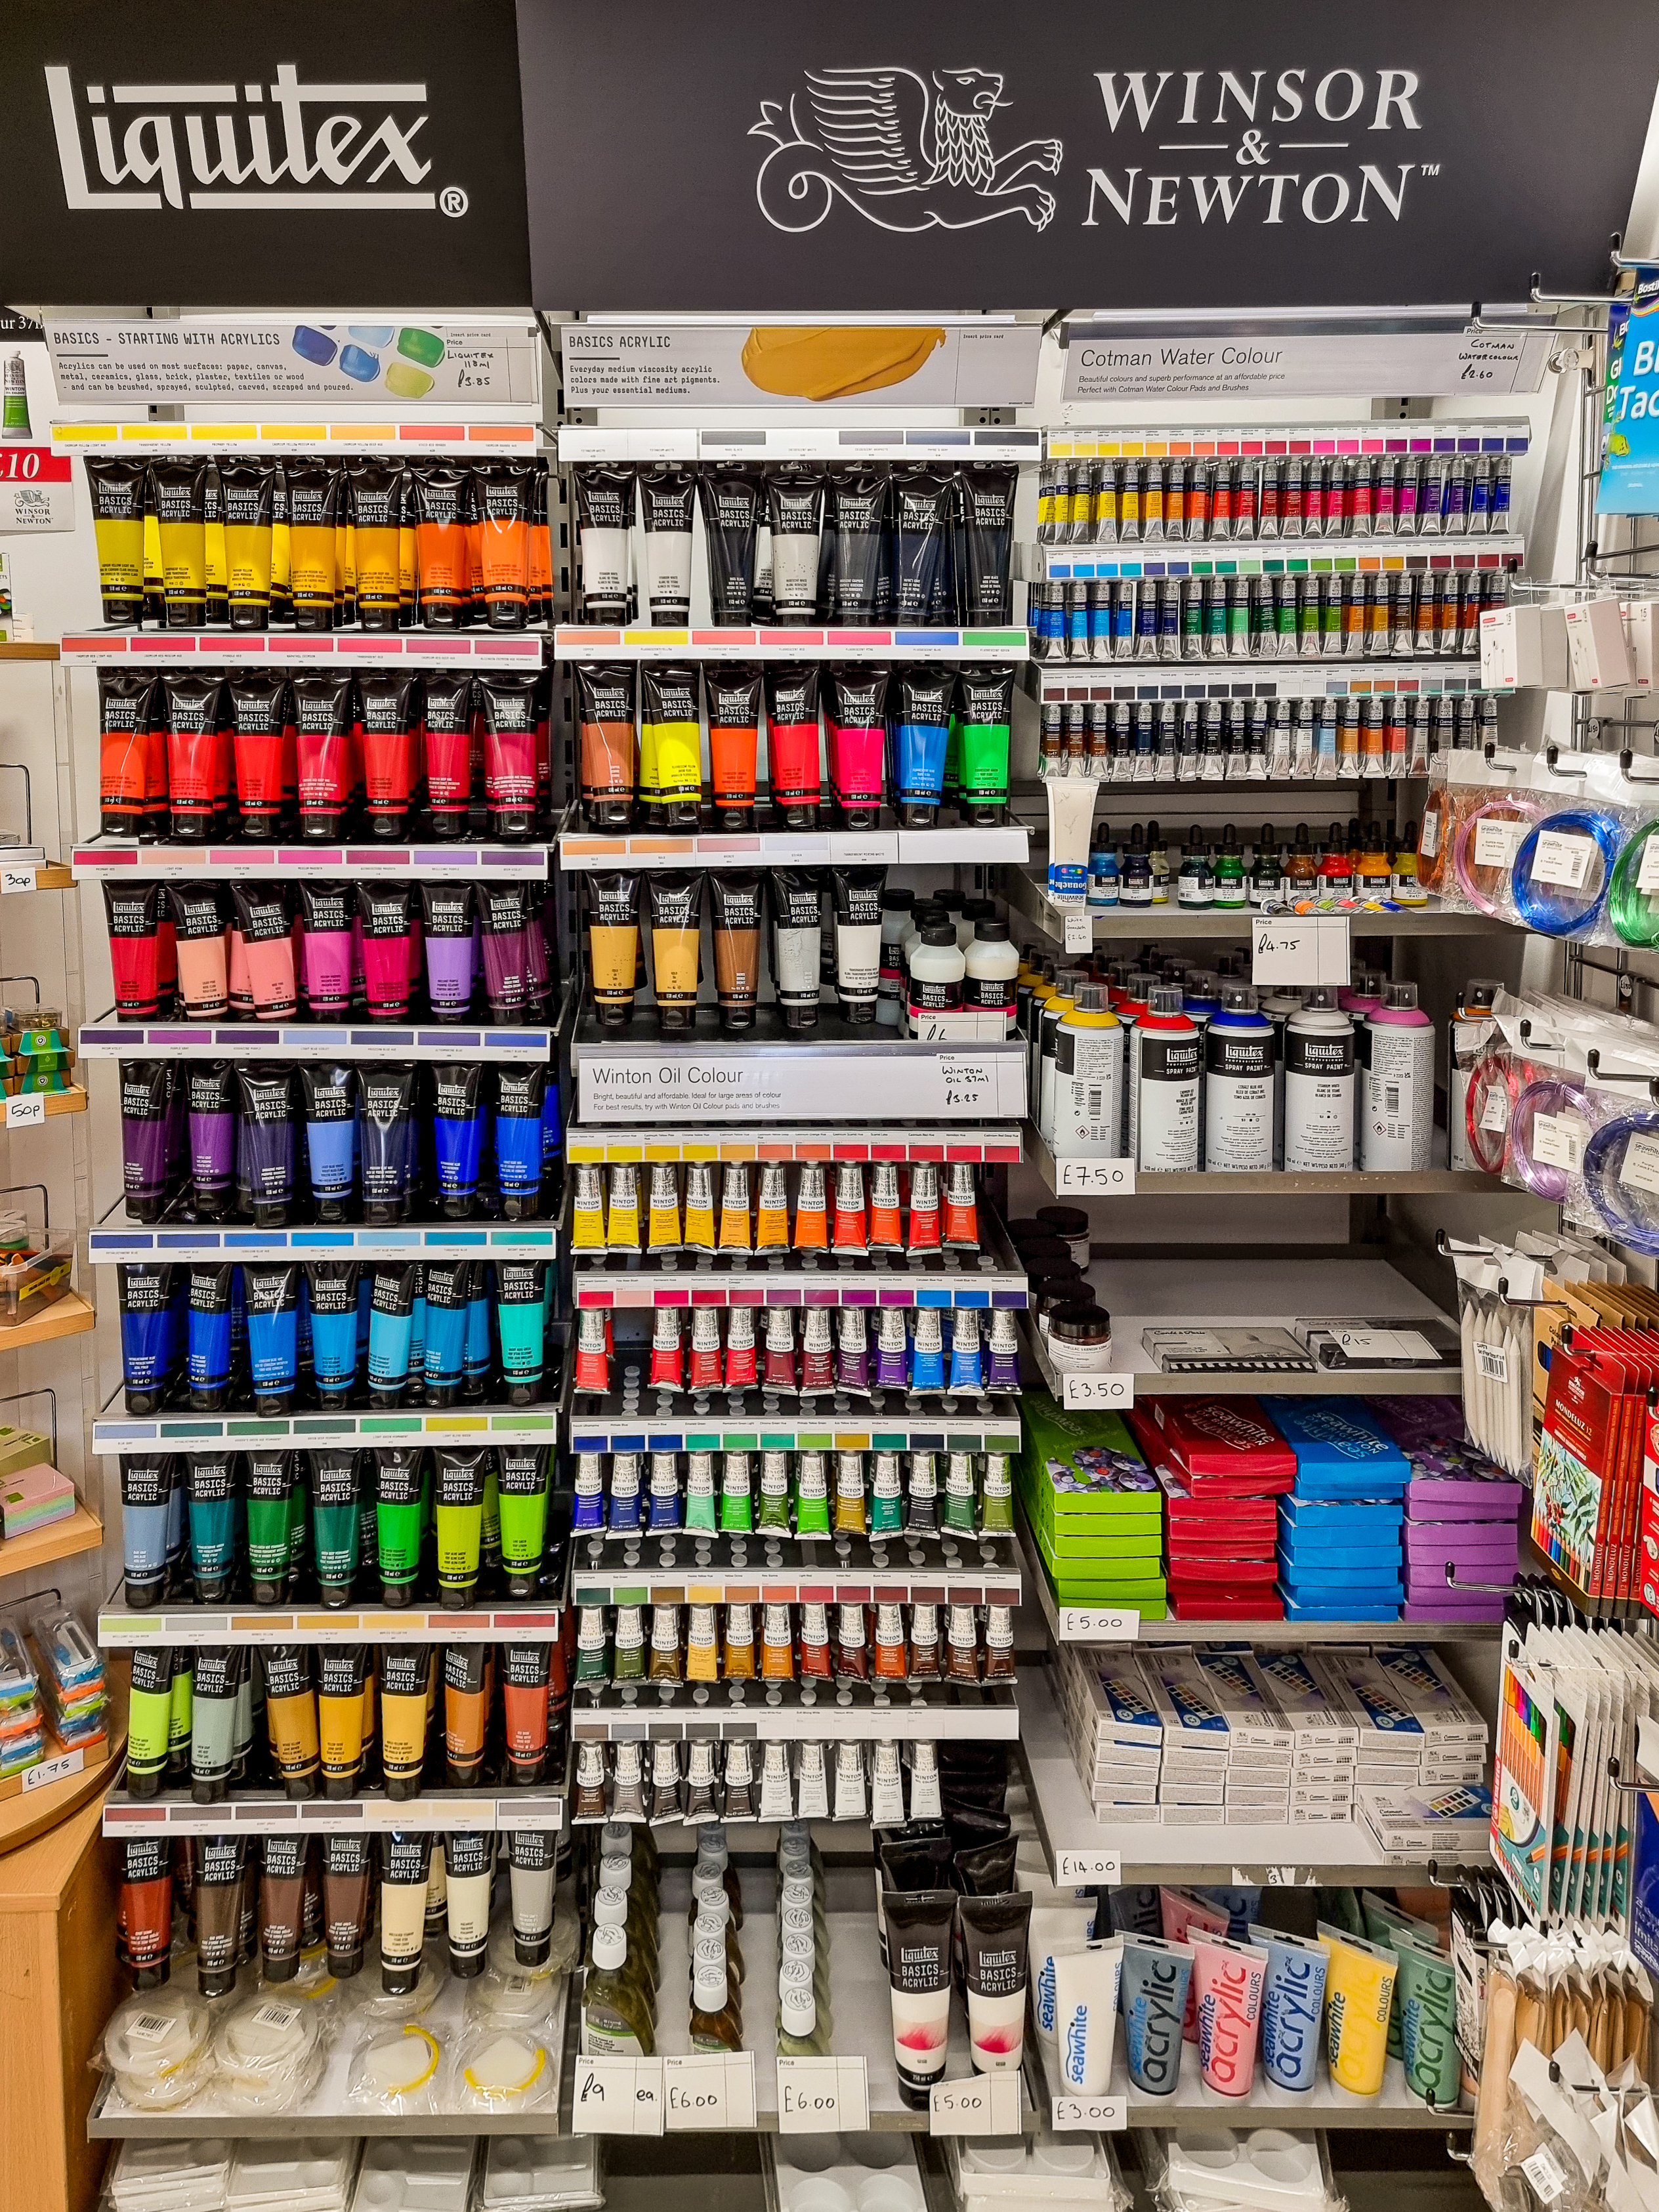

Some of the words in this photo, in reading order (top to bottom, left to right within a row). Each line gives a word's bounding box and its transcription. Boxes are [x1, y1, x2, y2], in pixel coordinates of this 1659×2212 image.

[1093, 68, 1423, 133] WINSOR
[1235, 129, 1270, 166] &
[54, 332, 99, 344] BASICS
[118, 333, 178, 345] STARTING
[184, 333, 215, 345] WITH
[221, 333, 280, 345] ACRYLICS
[569, 336, 614, 348] BASICS
[620, 336, 671, 348] ACRYLIC
[1471, 339, 1515, 350] COTMAN
[1081, 349, 1152, 367] Cotman
[1160, 348, 1215, 365] Water
[1221, 346, 1283, 364] Colour
[59, 362, 94, 371] Acrylics
[227, 364, 253, 372] paper,
[570, 365, 605, 375] Everyday
[639, 365, 678, 375] viscosity
[681, 365, 713, 375] acrylic
[1461, 364, 1493, 380] £2.60
[136, 373, 162, 382] glass,
[165, 373, 192, 381] brick,
[196, 373, 230, 383] plaster,
[681, 376, 721, 385] pigments.
[1149, 375, 1171, 383] superb
[1173, 374, 1214, 383] performance
[1269, 373, 1285, 382] price
[117, 383, 153, 392] brushed,
[157, 383, 192, 392] sprayed,
[195, 383, 234, 392] sculpted,
[238, 383, 268, 392] carved,
[272, 384, 304, 393] scraped
[324, 384, 354, 392] poured.
[591, 387, 610, 396] your
[161, 486, 191, 498] Liquitex
[161, 501, 191, 509] BASICS
[161, 509, 190, 518] ACRYLIC
[1258, 934, 1300, 953] £4.75
[1225, 1044, 1264, 1060] Liquitex
[593, 1068, 652, 1084] Winton
[659, 1067, 681, 1083] Oil
[688, 1066, 744, 1083] Colour
[942, 1066, 982, 1075] WINTON
[593, 1093, 614, 1101] Bright,
[718, 1092, 734, 1100] large
[12, 1104, 40, 1117] 50p
[1063, 1165, 1124, 1185] £7.50
[1341, 1333, 1372, 1347] £15
[1069, 1381, 1125, 1400] £3.50
[1555, 1398, 1585, 1430] MONDELUZ
[1586, 1426, 1593, 1436] 12
[1066, 1614, 1122, 1630] £5.00
[28, 1759, 70, 1785] £1.75
[390, 1843, 421, 1856] Liquitex
[391, 1858, 421, 1870] BASICS
[1062, 1856, 1116, 1875] £14.00
[390, 1868, 419, 1879] ACRYLIC
[901, 1947, 939, 1962] Liquitex
[902, 1965, 939, 1978] BASICS
[902, 1976, 938, 1988] ACRYLIC
[1312, 1966, 1326, 2014] COLOURS
[1276, 1955, 1311, 2079] acrylic
[1264, 1990, 1280, 2068] seawhite
[1066, 2005, 1087, 2085] seawhite
[670, 2087, 717, 2109] £6.00
[784, 2085, 835, 2112] £6.00
[934, 2095, 982, 2112] £5.00
[1057, 2102, 1116, 2119] £3.00
